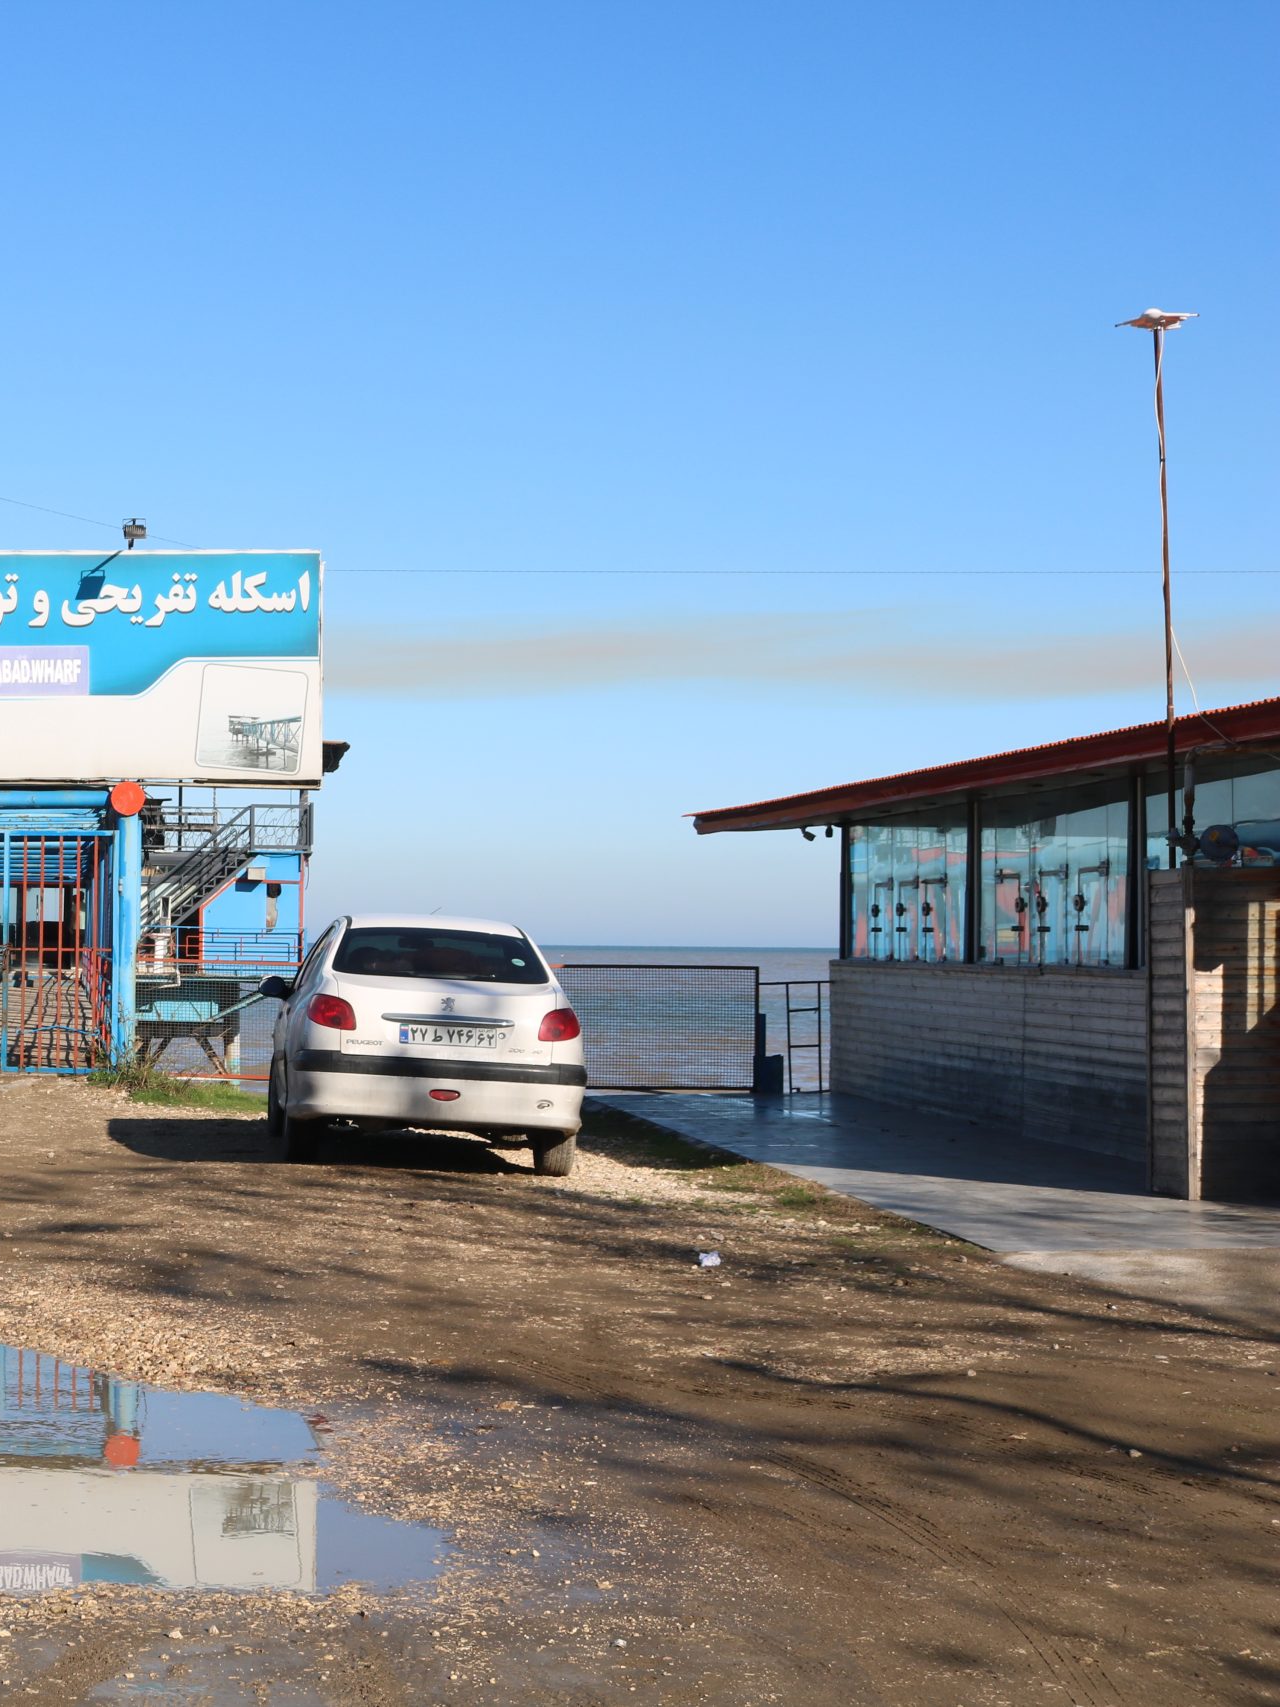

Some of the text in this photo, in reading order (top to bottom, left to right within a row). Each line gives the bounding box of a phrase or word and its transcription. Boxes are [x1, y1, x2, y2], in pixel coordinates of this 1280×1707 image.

[28, 589, 50, 627] و
[61, 572, 198, 628] تفریحی
[208, 570, 311, 613] اسکله
